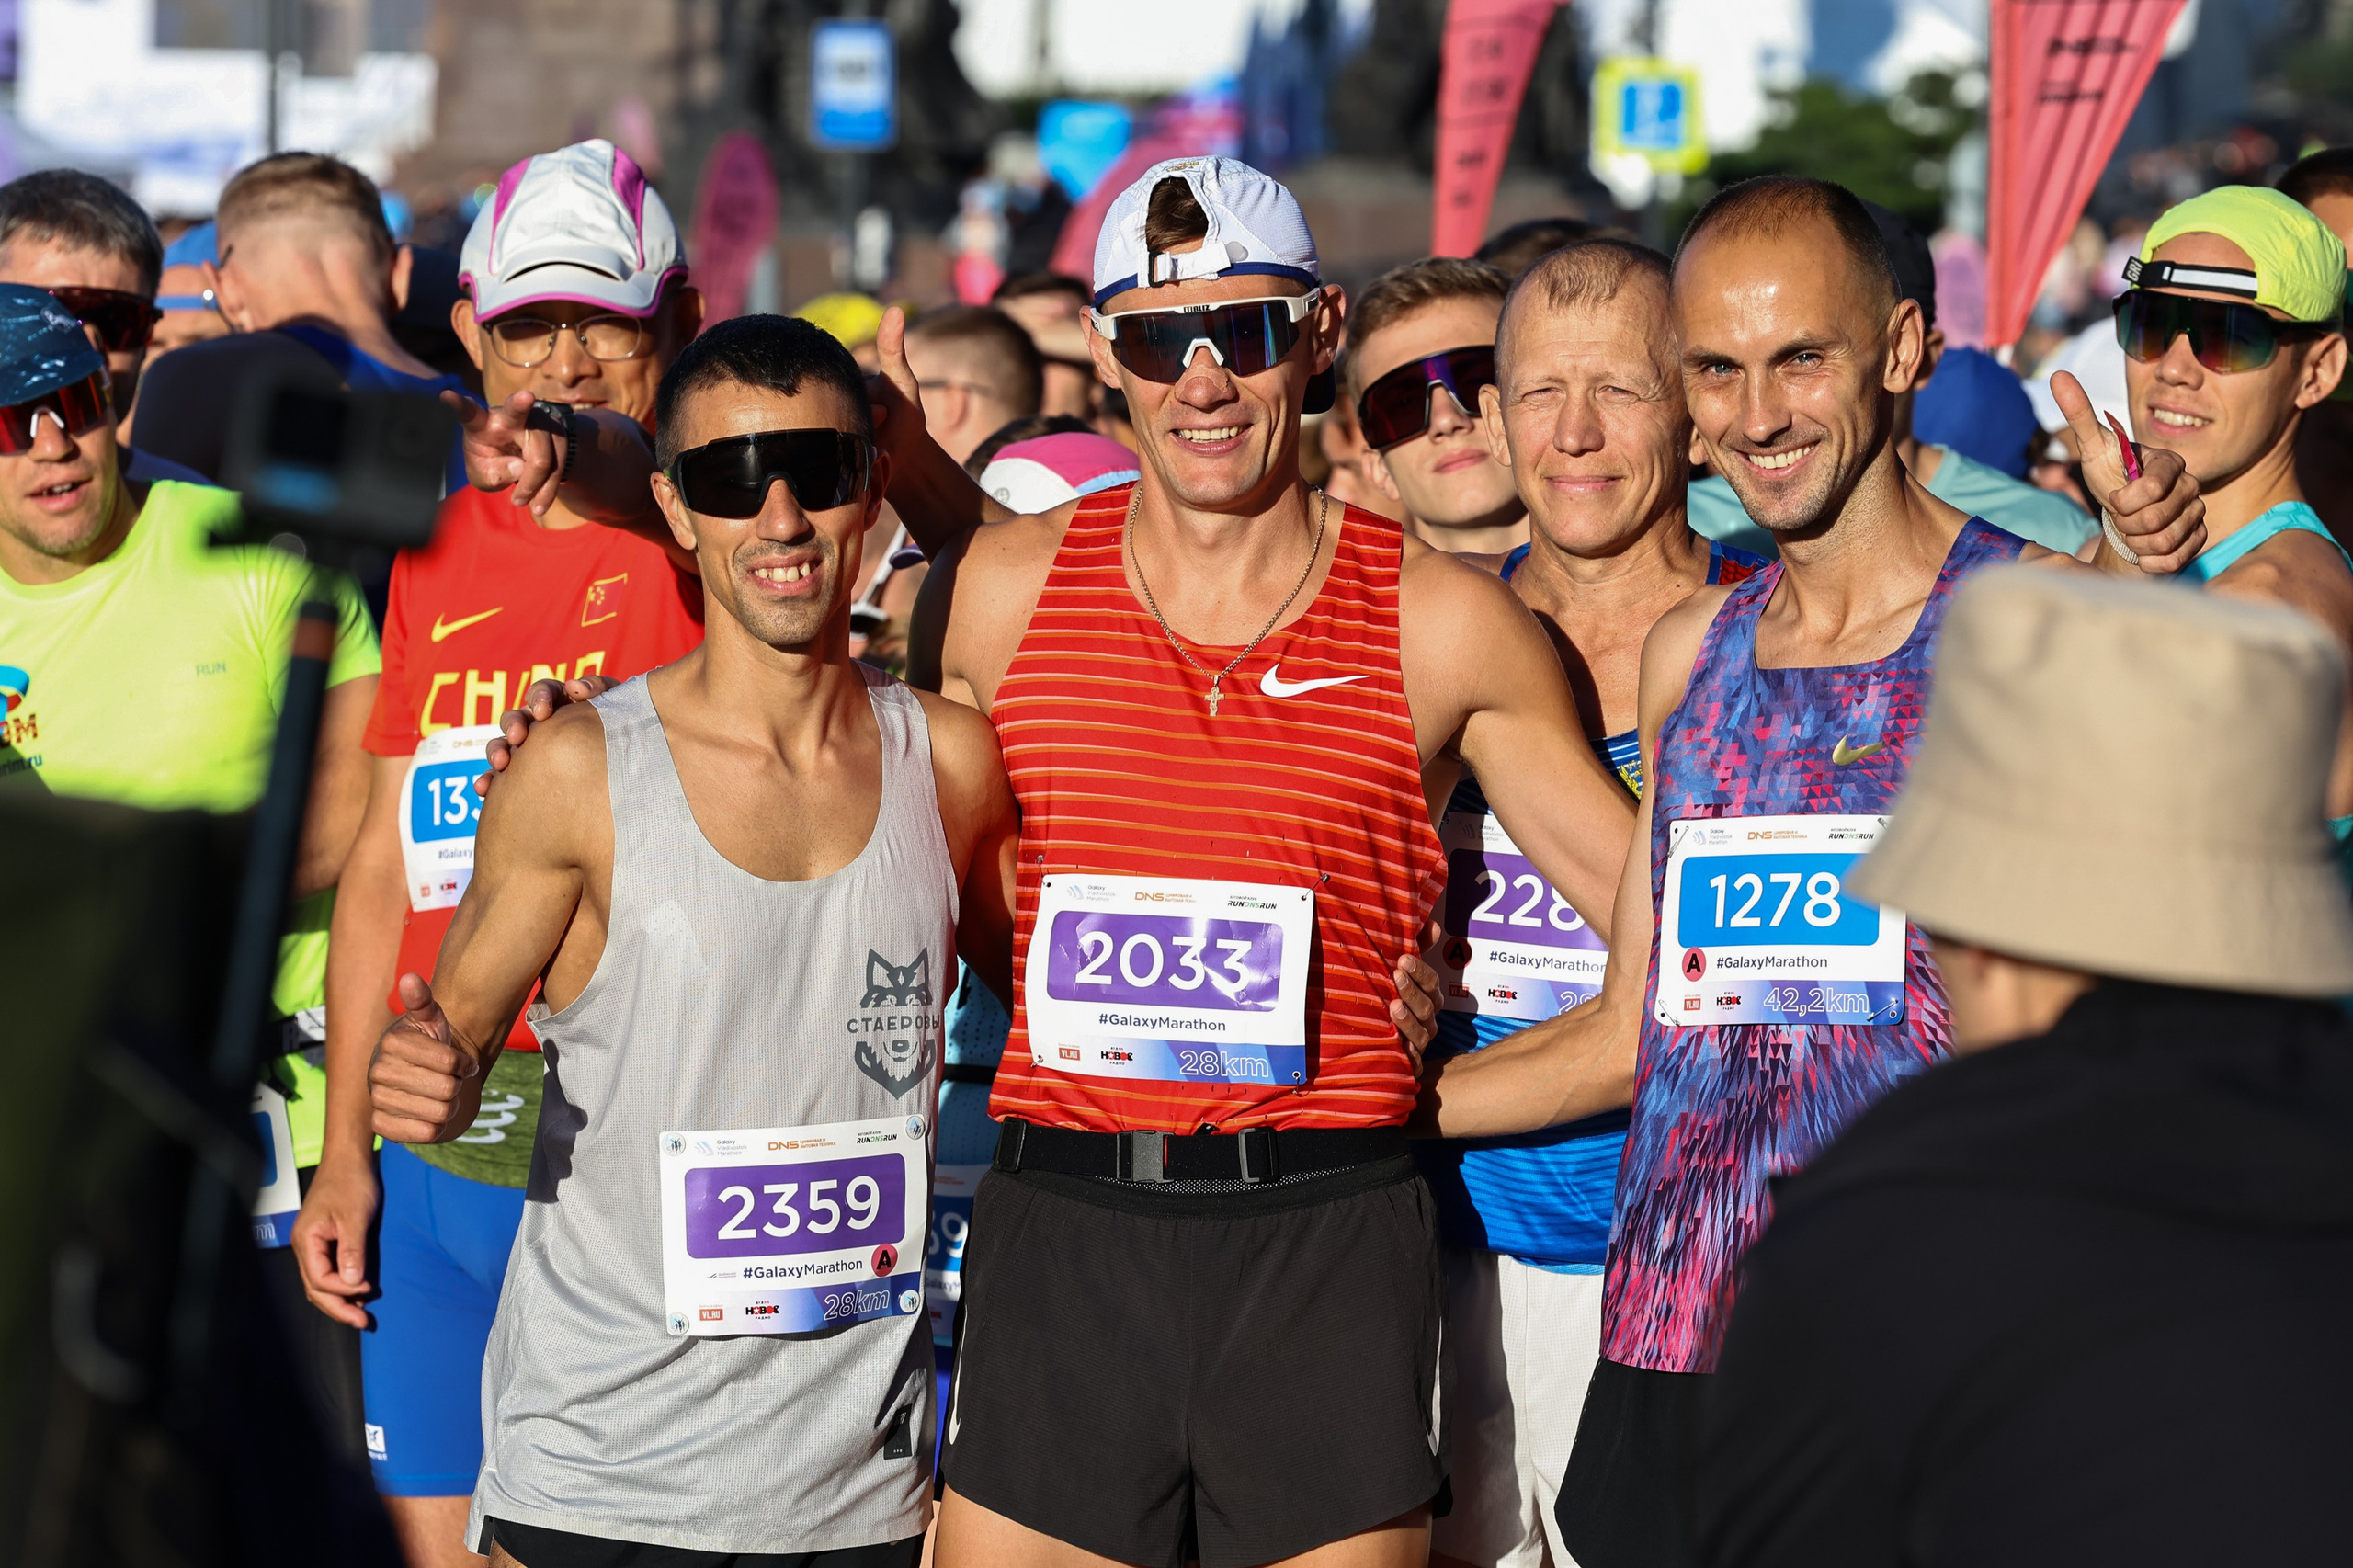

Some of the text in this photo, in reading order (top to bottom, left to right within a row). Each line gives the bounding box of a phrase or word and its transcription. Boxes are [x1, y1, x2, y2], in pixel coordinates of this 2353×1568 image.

[195, 662, 227, 676] RUN
[1747, 831, 1772, 840] DNS
[1134, 892, 1164, 902] DNS
[1709, 872, 1841, 927] 1278
[1449, 942, 1466, 962] A
[1075, 931, 1252, 994] 2033
[1686, 953, 1701, 973] A
[1716, 955, 1828, 970] #GalaxyMarathon
[1763, 987, 1870, 1017] 42,2km
[847, 1015, 940, 1034] СТАЕРОВЫ
[1098, 1014, 1226, 1031] #GalaxyMarathon
[1179, 1050, 1269, 1077] 28km
[768, 1140, 800, 1151] DNS
[718, 1176, 880, 1239] 2359
[743, 1259, 863, 1279] #GalaxyMarathon
[876, 1250, 892, 1270] A
[824, 1289, 891, 1322] 28km
